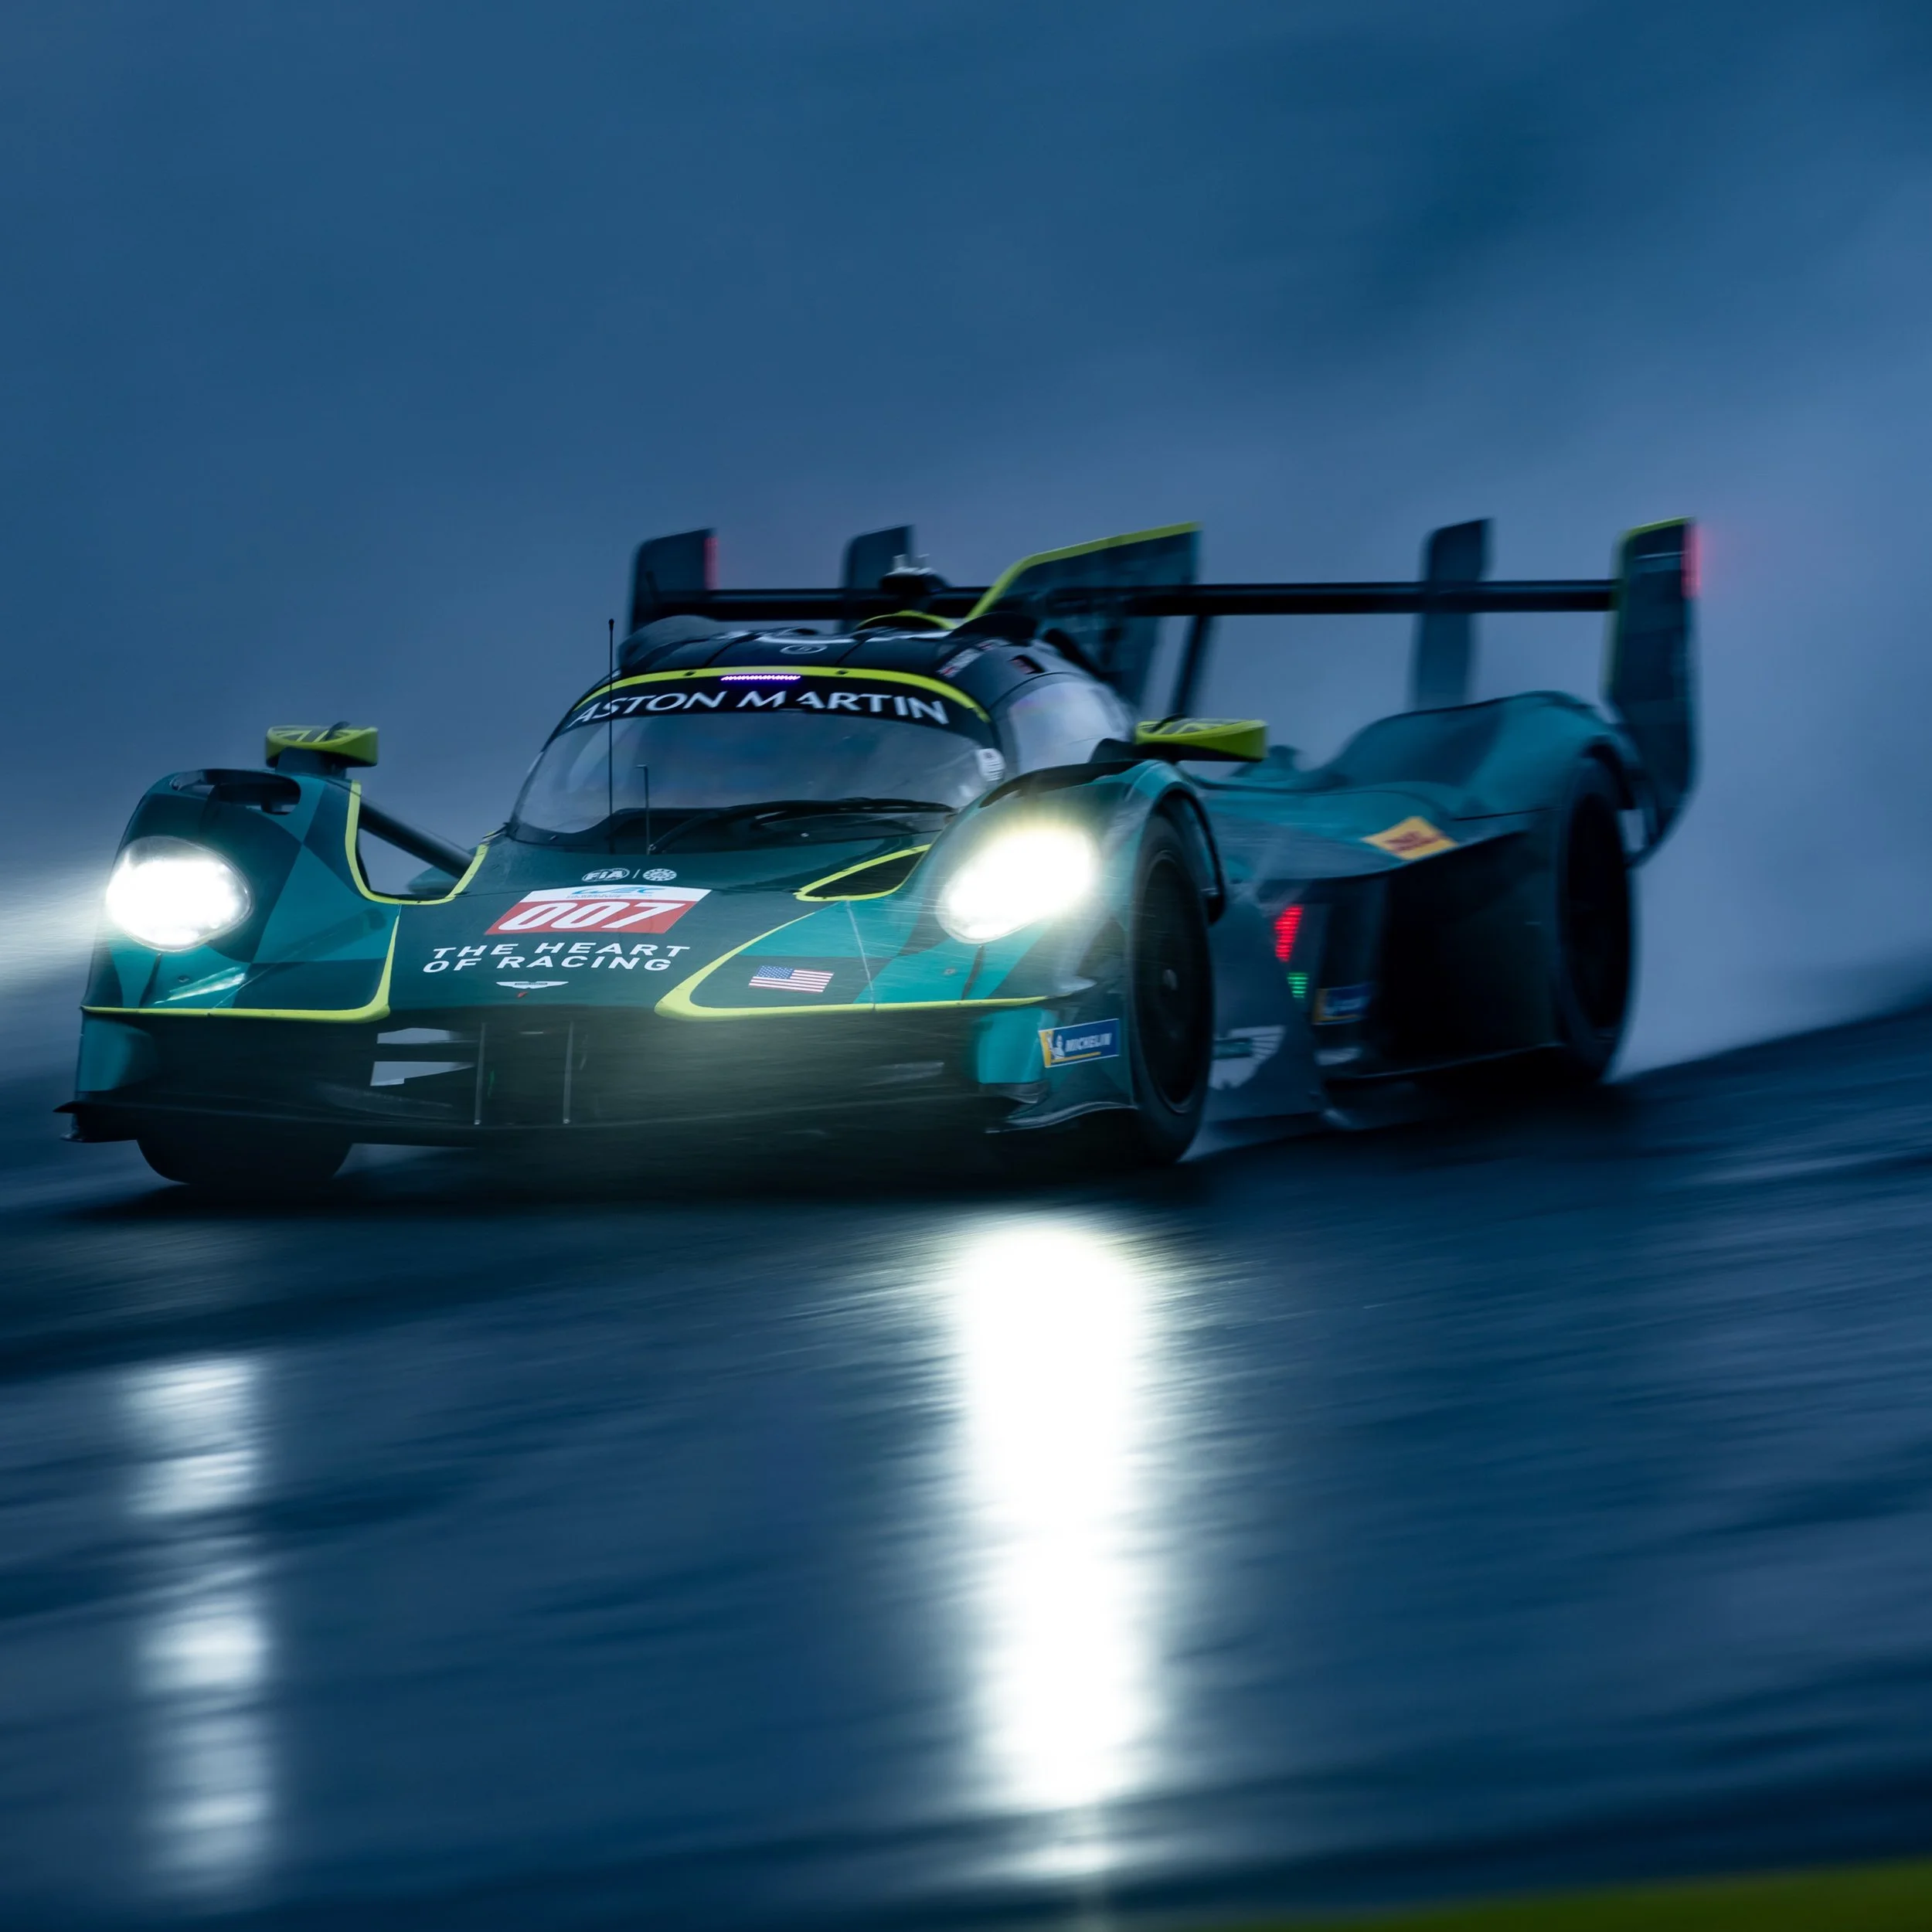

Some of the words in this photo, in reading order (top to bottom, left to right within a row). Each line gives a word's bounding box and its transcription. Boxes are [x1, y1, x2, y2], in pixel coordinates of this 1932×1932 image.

[568, 691, 729, 726] ASTON
[736, 690, 949, 725] MARTIN
[584, 869, 624, 881] FIA
[498, 902, 685, 930] 007
[434, 944, 519, 958] THE
[534, 941, 690, 958] HEART
[423, 958, 481, 973] OF
[497, 955, 671, 971] RACING
